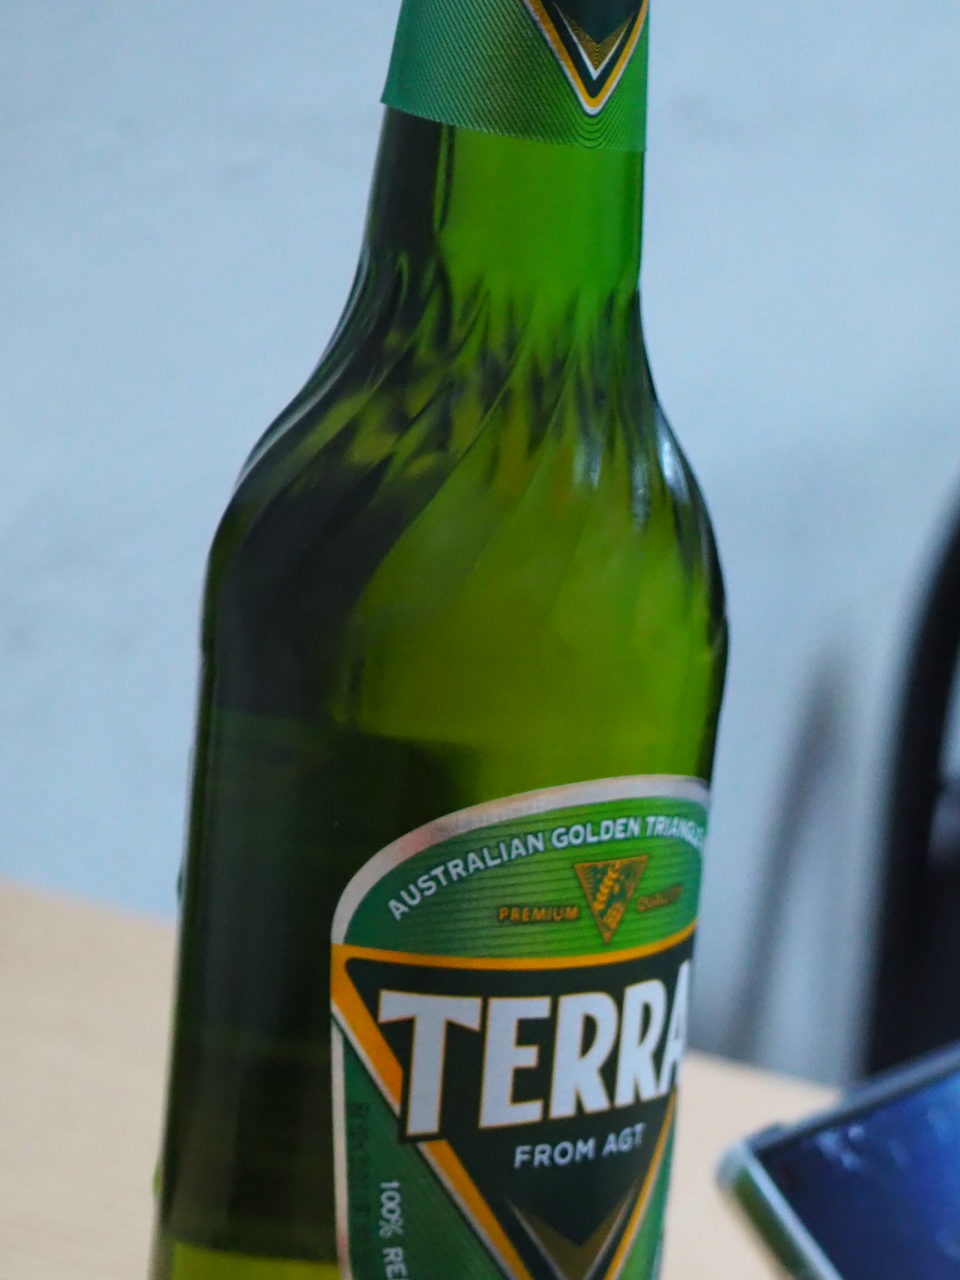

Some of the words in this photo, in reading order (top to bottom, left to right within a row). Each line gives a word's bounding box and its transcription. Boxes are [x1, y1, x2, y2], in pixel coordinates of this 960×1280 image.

[387, 832, 545, 921] AUSTRALIAN
[551, 816, 641, 849] GOLDEN
[498, 905, 580, 923] PREMIUM
[377, 958, 691, 1136] TERRA
[513, 1137, 596, 1170] FROM
[602, 1122, 647, 1157] AGT
[379, 1180, 405, 1239] 100%
